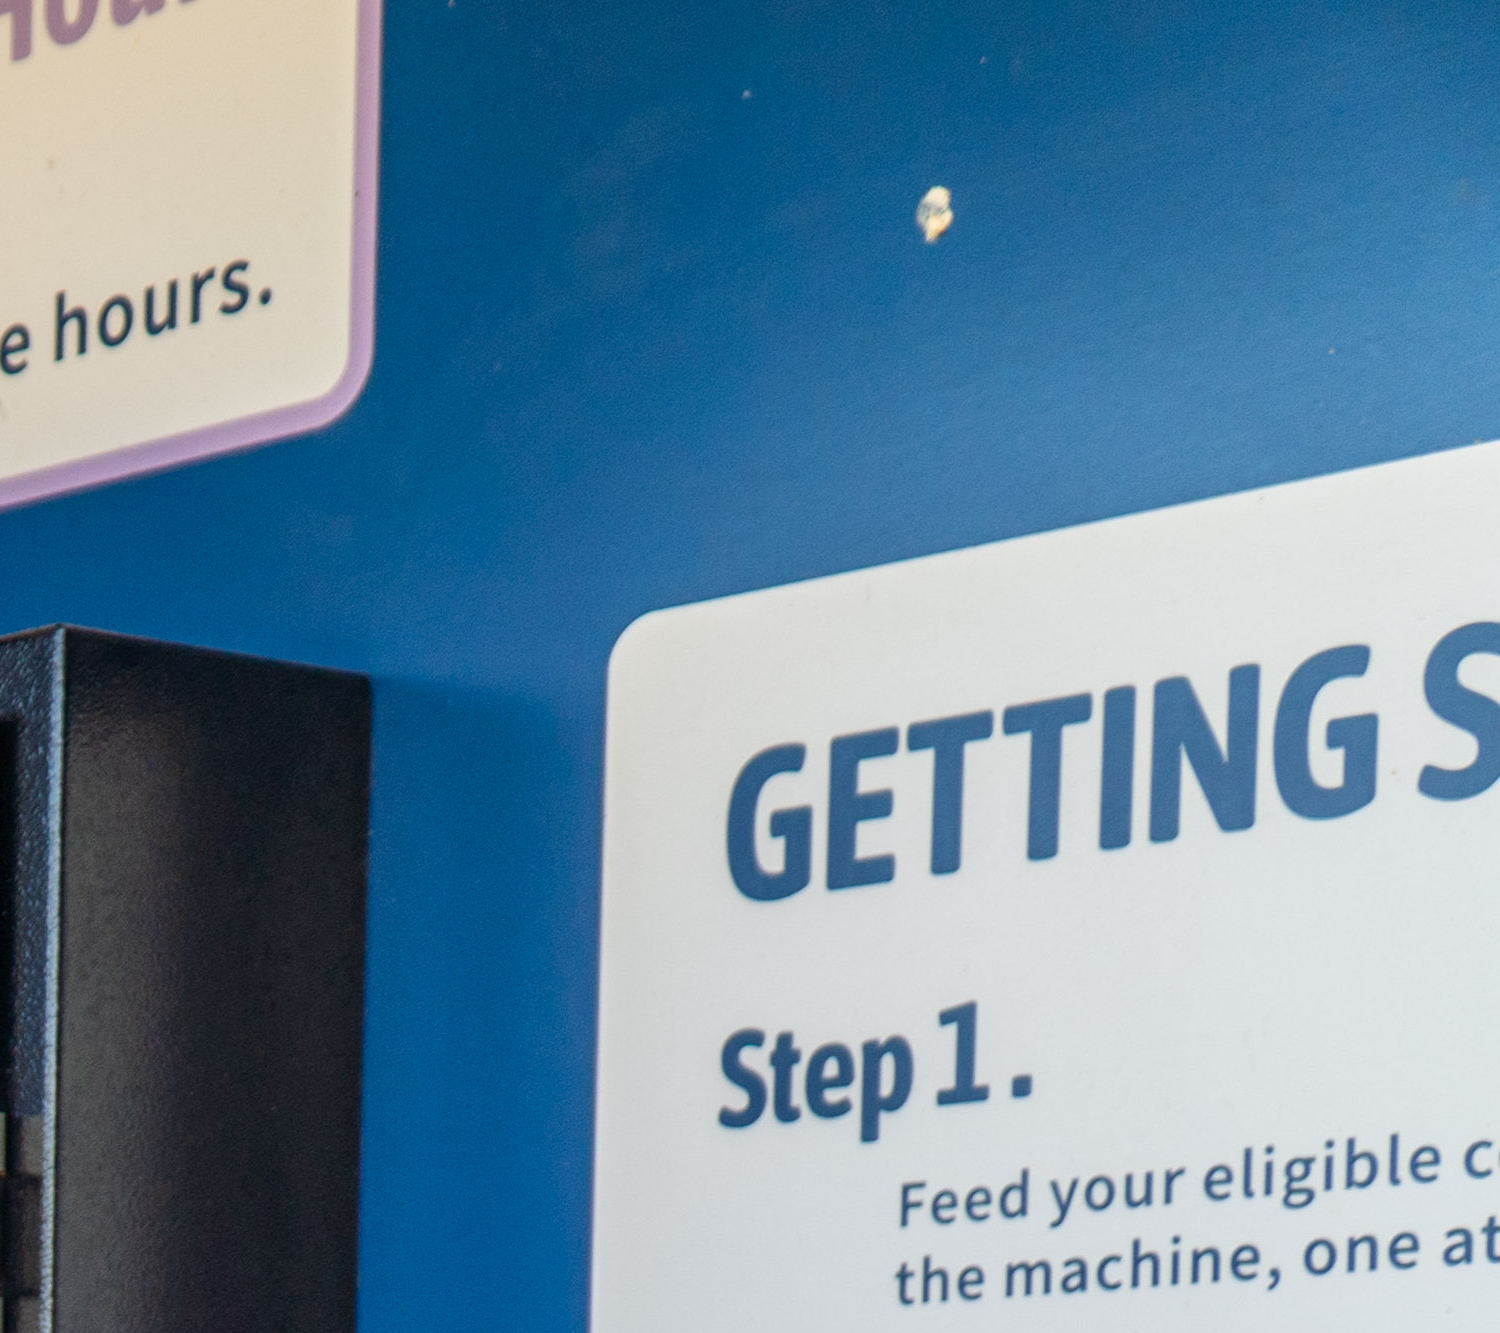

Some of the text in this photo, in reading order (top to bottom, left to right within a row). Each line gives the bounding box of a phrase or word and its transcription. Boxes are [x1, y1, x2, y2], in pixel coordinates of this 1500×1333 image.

[54, 260, 272, 362] hours.
[725, 644, 1379, 903] GETTING
[718, 1001, 1033, 1144] Step 1.
[899, 1167, 1030, 1228] Feed
[1049, 1167, 1186, 1229] your
[1203, 1133, 1442, 1210] eligible
[894, 1255, 985, 1306] the
[1005, 1235, 1281, 1298] machine,
[1303, 1231, 1420, 1277] one
